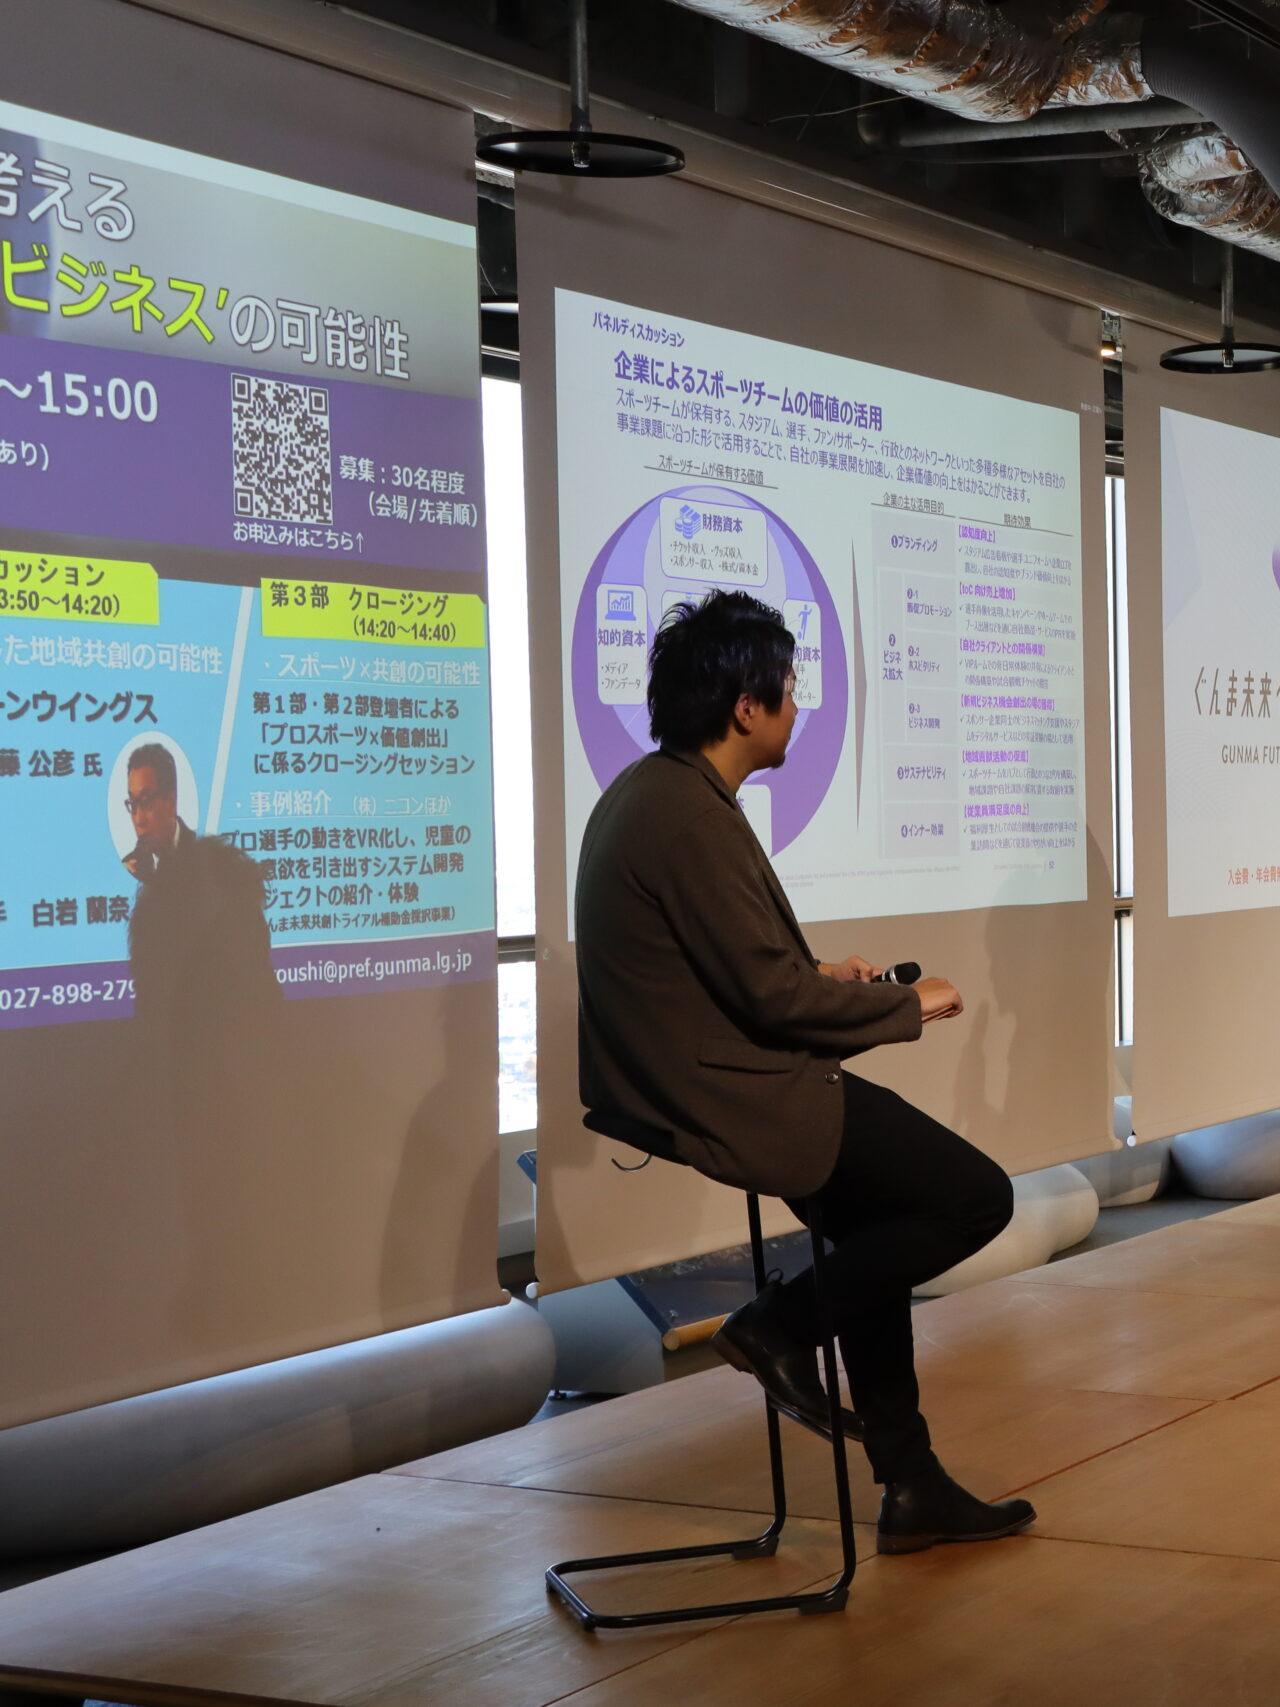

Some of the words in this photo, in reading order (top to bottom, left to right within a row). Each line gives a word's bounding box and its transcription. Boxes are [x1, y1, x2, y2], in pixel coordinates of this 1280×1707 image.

[593, 311, 685, 347] パネルディスカッション
[613, 350, 883, 432] 企業によるスポーツチームの価値の活用
[657, 455, 764, 485] スポーツチームが保有する価値
[882, 491, 944, 515] 企業の主な活用目的
[702, 513, 743, 533] 財務資本
[348, 587, 448, 619] クロージング
[597, 629, 646, 648] 知的資本
[0, 690, 158, 724] ンウイングス
[28, 749, 75, 778] 公彦
[83, 752, 103, 777] 氏
[254, 750, 475, 776] に係るクロージングセッション
[1221, 745, 1260, 765] GUNMA
[32, 897, 78, 927] 白岩
[273, 949, 472, 984] oushi@pref.gunma.lg.jp
